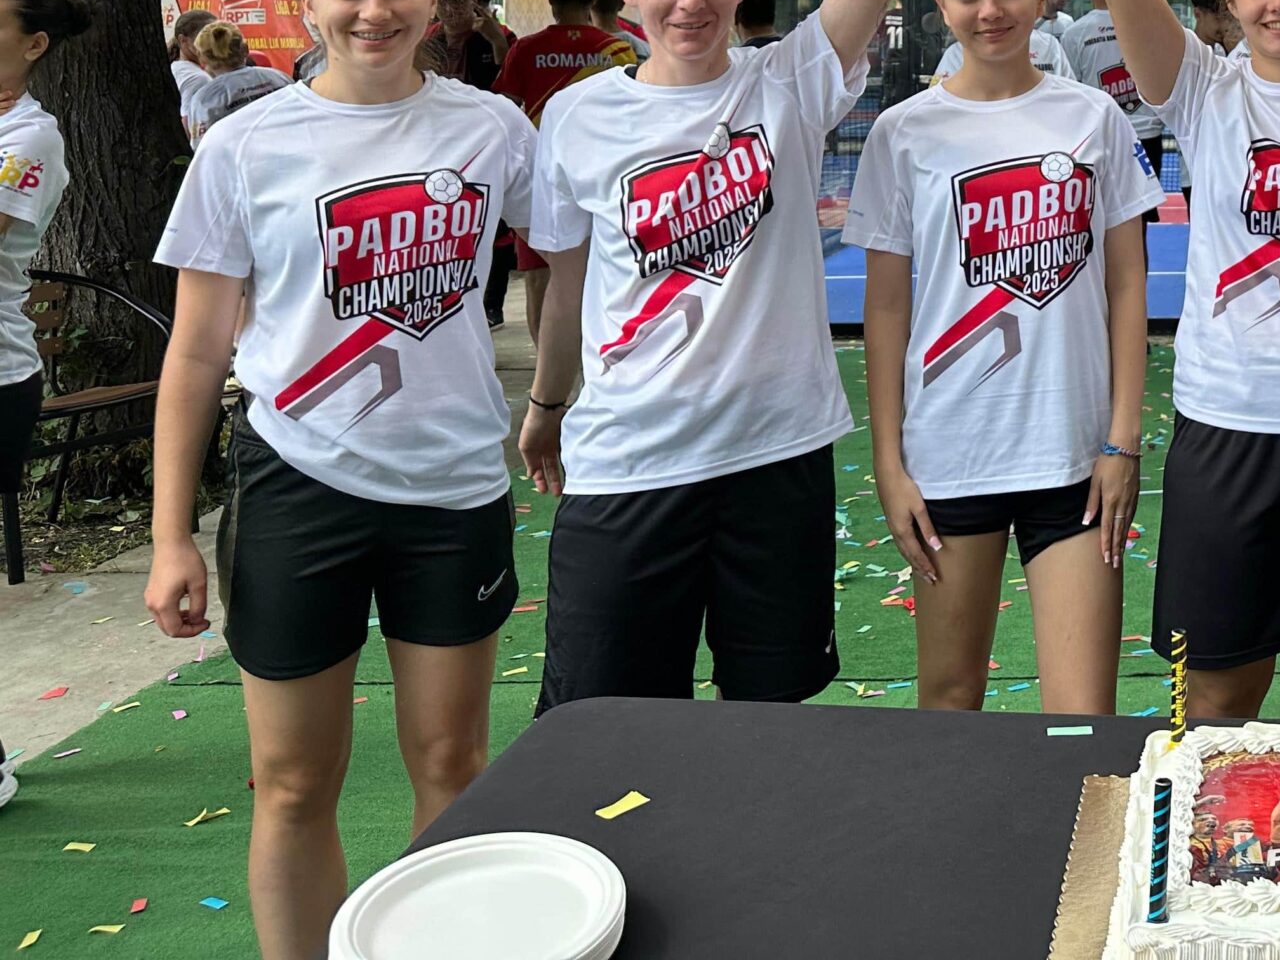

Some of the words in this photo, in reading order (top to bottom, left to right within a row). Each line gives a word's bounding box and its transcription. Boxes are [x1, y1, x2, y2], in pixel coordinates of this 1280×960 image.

[535, 52, 614, 68] ROMANIA
[669, 182, 756, 241] NATIONAL
[961, 177, 1094, 238] PADBOL
[326, 198, 484, 267] PADBOL
[998, 213, 1076, 250] NATIONAL
[373, 239, 459, 277] NATIONAL
[1023, 268, 1060, 295] 2025
[404, 295, 444, 326] 2025
